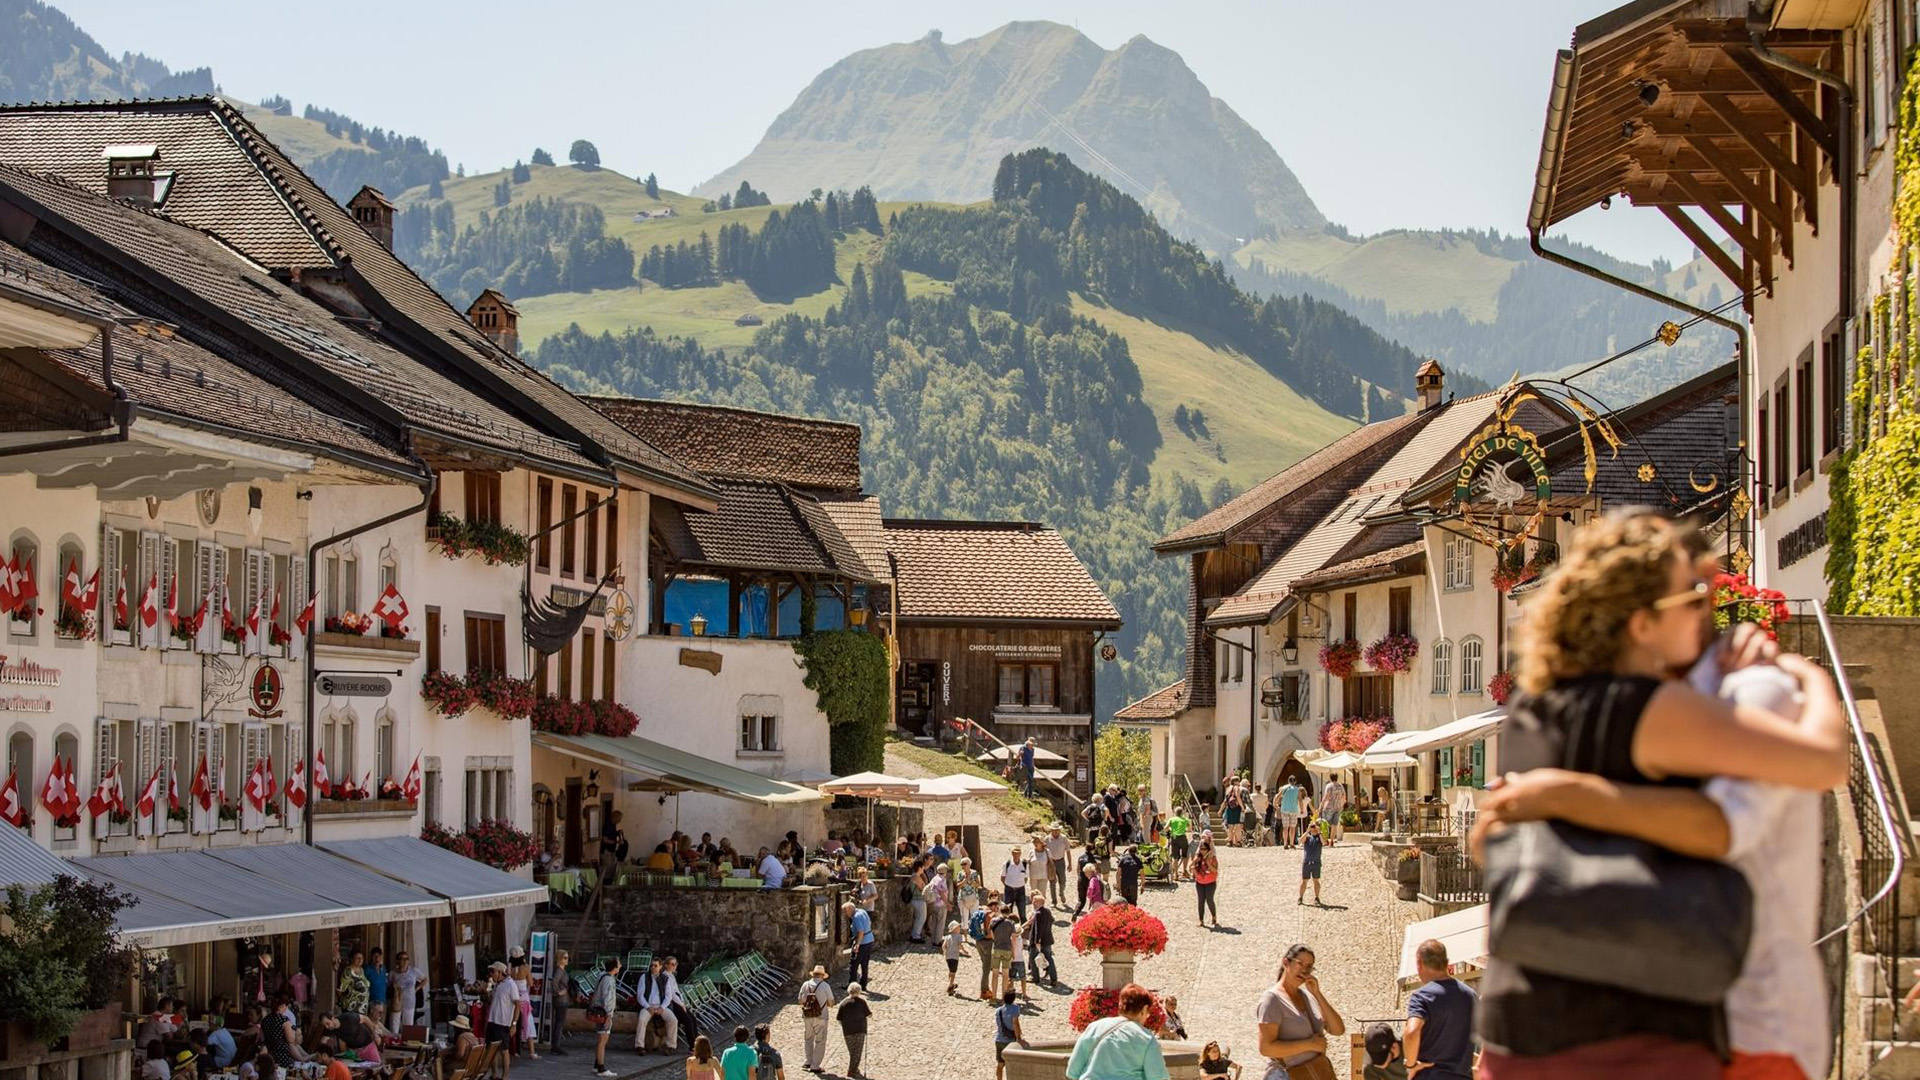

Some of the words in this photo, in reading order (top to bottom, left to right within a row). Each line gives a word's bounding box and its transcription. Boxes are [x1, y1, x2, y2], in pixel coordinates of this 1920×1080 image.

[1457, 443, 1493, 488] HOTEL
[1495, 437, 1519, 450] DE
[1522, 445, 1550, 487] VILLE
[1028, 644, 1062, 652] GRUYÈRES
[360, 683, 386, 693] ROOMS
